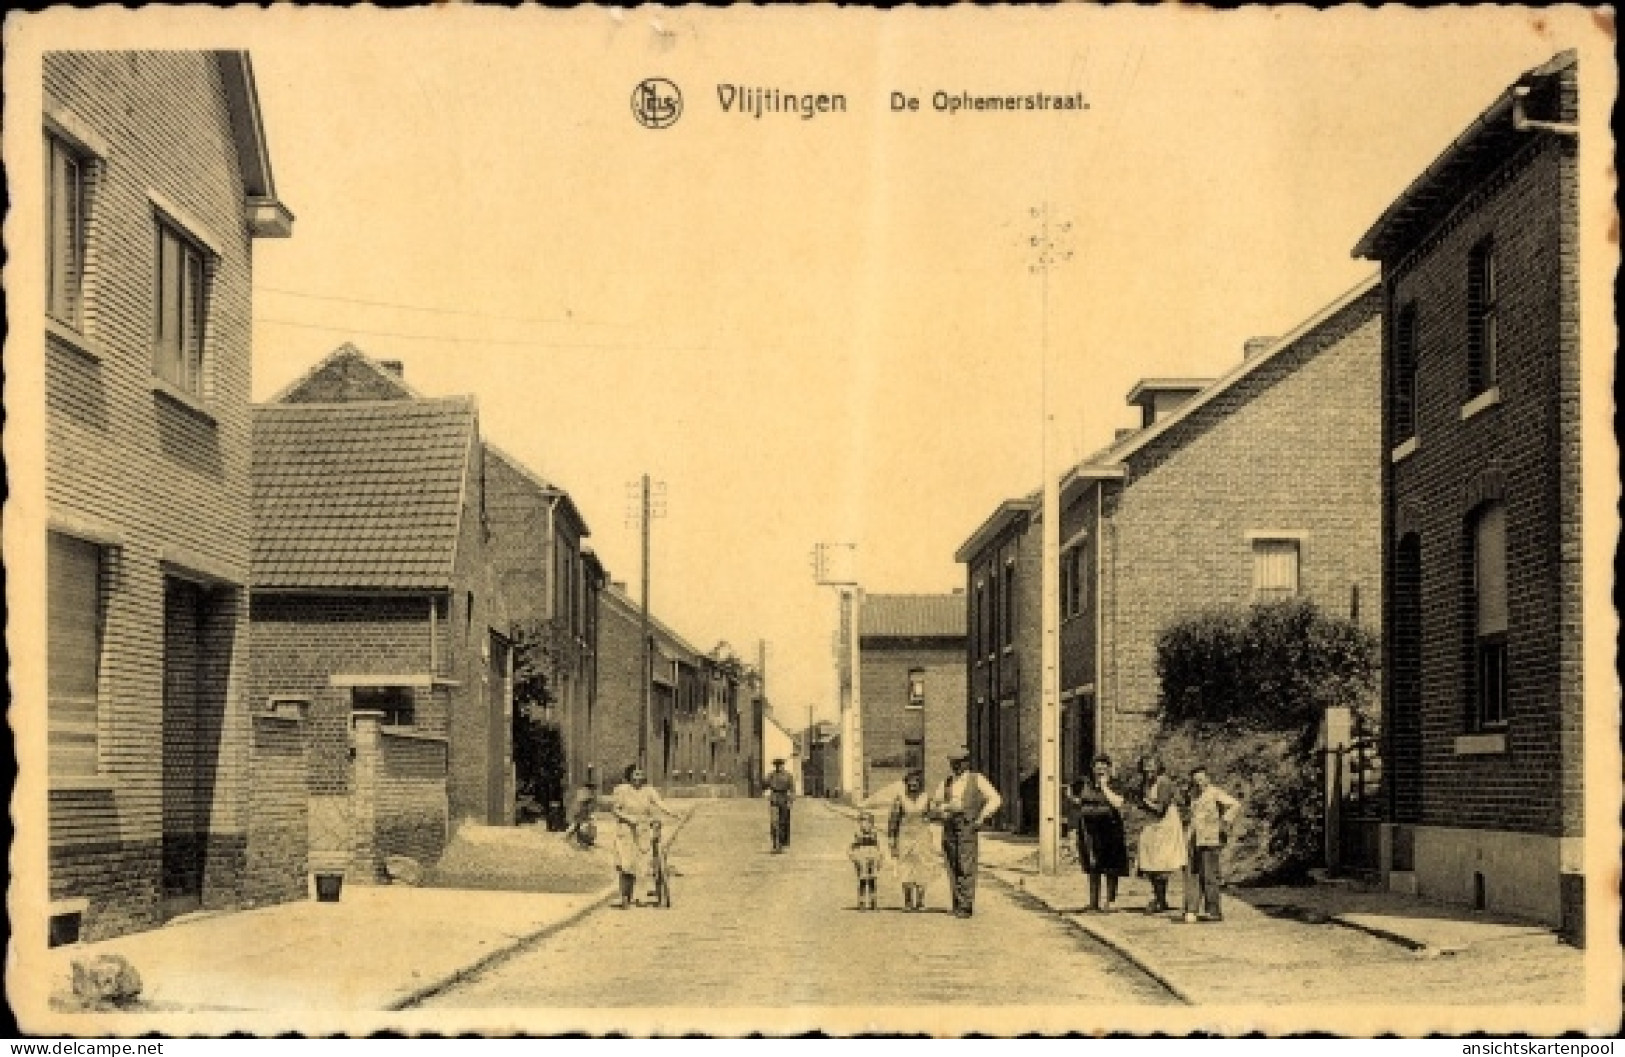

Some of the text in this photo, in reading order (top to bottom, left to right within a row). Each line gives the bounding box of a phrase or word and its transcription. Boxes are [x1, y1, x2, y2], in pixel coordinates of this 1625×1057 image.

[717, 84, 1091, 120] Vlijtingen De Ophemerstraat.
